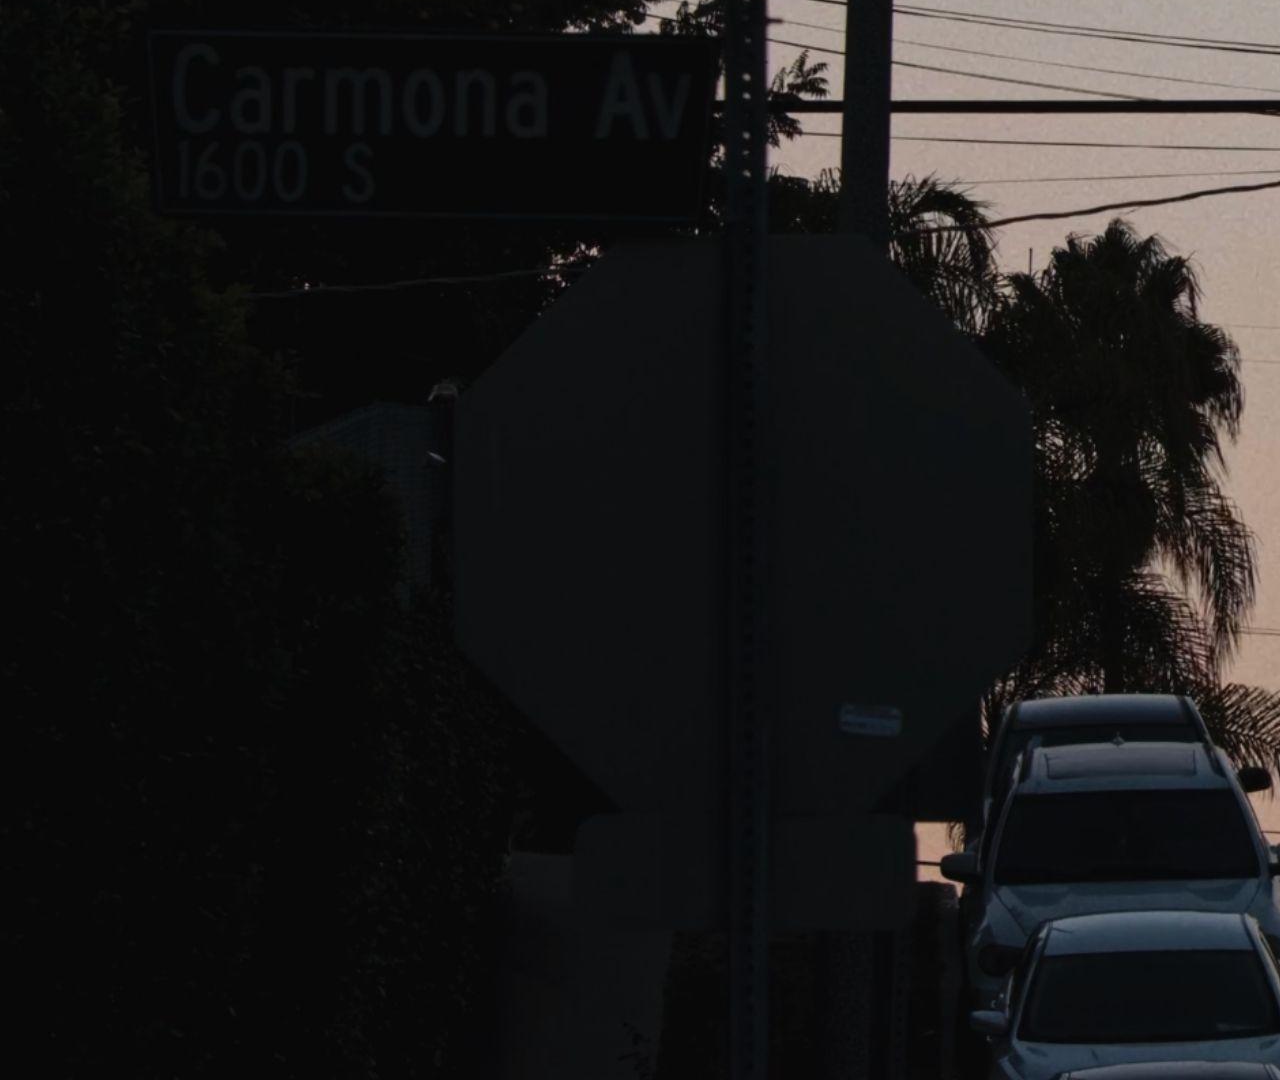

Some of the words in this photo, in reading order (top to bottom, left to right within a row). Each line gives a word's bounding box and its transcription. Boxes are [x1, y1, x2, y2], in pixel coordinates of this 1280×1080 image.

[171, 43, 549, 138] Carmona
[594, 49, 691, 139] Av
[177, 139, 308, 201] 1600
[341, 141, 376, 203] S
